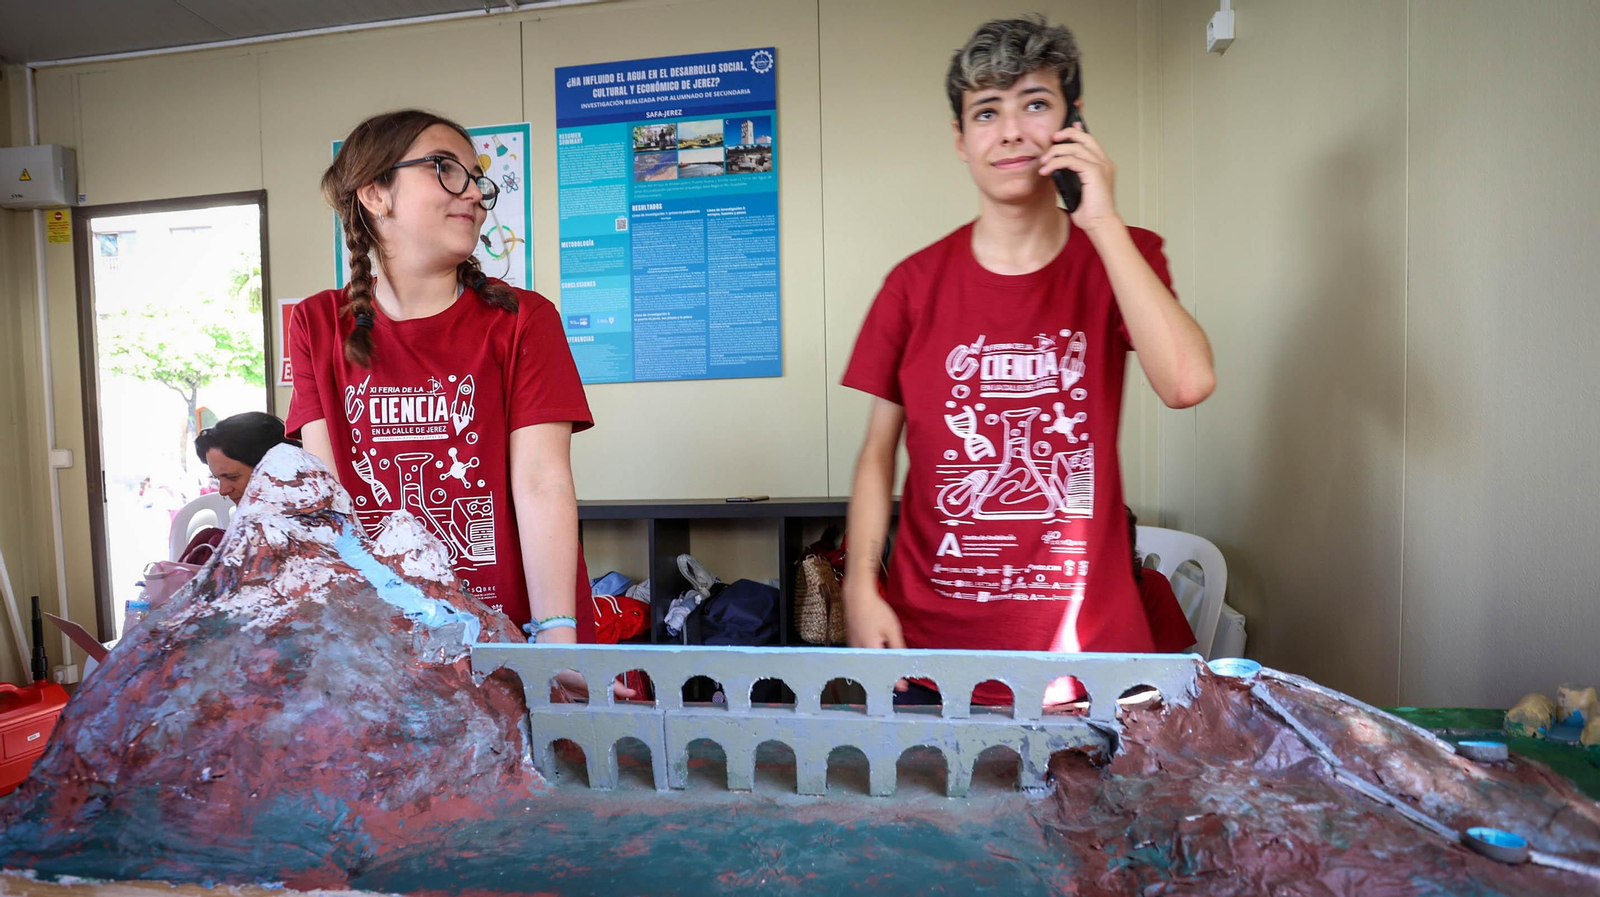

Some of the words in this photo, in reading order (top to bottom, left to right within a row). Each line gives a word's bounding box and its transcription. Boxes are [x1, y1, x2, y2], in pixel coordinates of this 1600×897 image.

[567, 77, 581, 88] ¿HA
[583, 73, 614, 85] INFLUIDO
[617, 72, 625, 82] EL
[627, 71, 646, 81] AGUA
[648, 69, 657, 79] EN
[660, 68, 668, 78] EL
[670, 64, 716, 77] DESARROLLO
[718, 61, 747, 73] SOCIAL,
[593, 85, 627, 98] CULTURAL
[630, 85, 634, 94] Y
[637, 81, 679, 94] ECONÓMICO
[681, 80, 691, 89] DE
[693, 77, 720, 89] JEREZ?
[581, 100, 624, 109] INVESTIGACIÓN
[625, 96, 656, 105] REALIZADA
[670, 92, 703, 101] ALUMNADO
[714, 88, 751, 97] SECUNDARIA
[646, 109, 683, 118] SAFA-JEREZ
[632, 203, 662, 211] RESULTADOS
[561, 239, 594, 248] METODOLOGÍA
[561, 280, 596, 289] CONCLUSIONES
[567, 335, 594, 343] FERENCIAS
[369, 395, 449, 424] CIENCIA
[392, 426, 414, 434] CALLE
